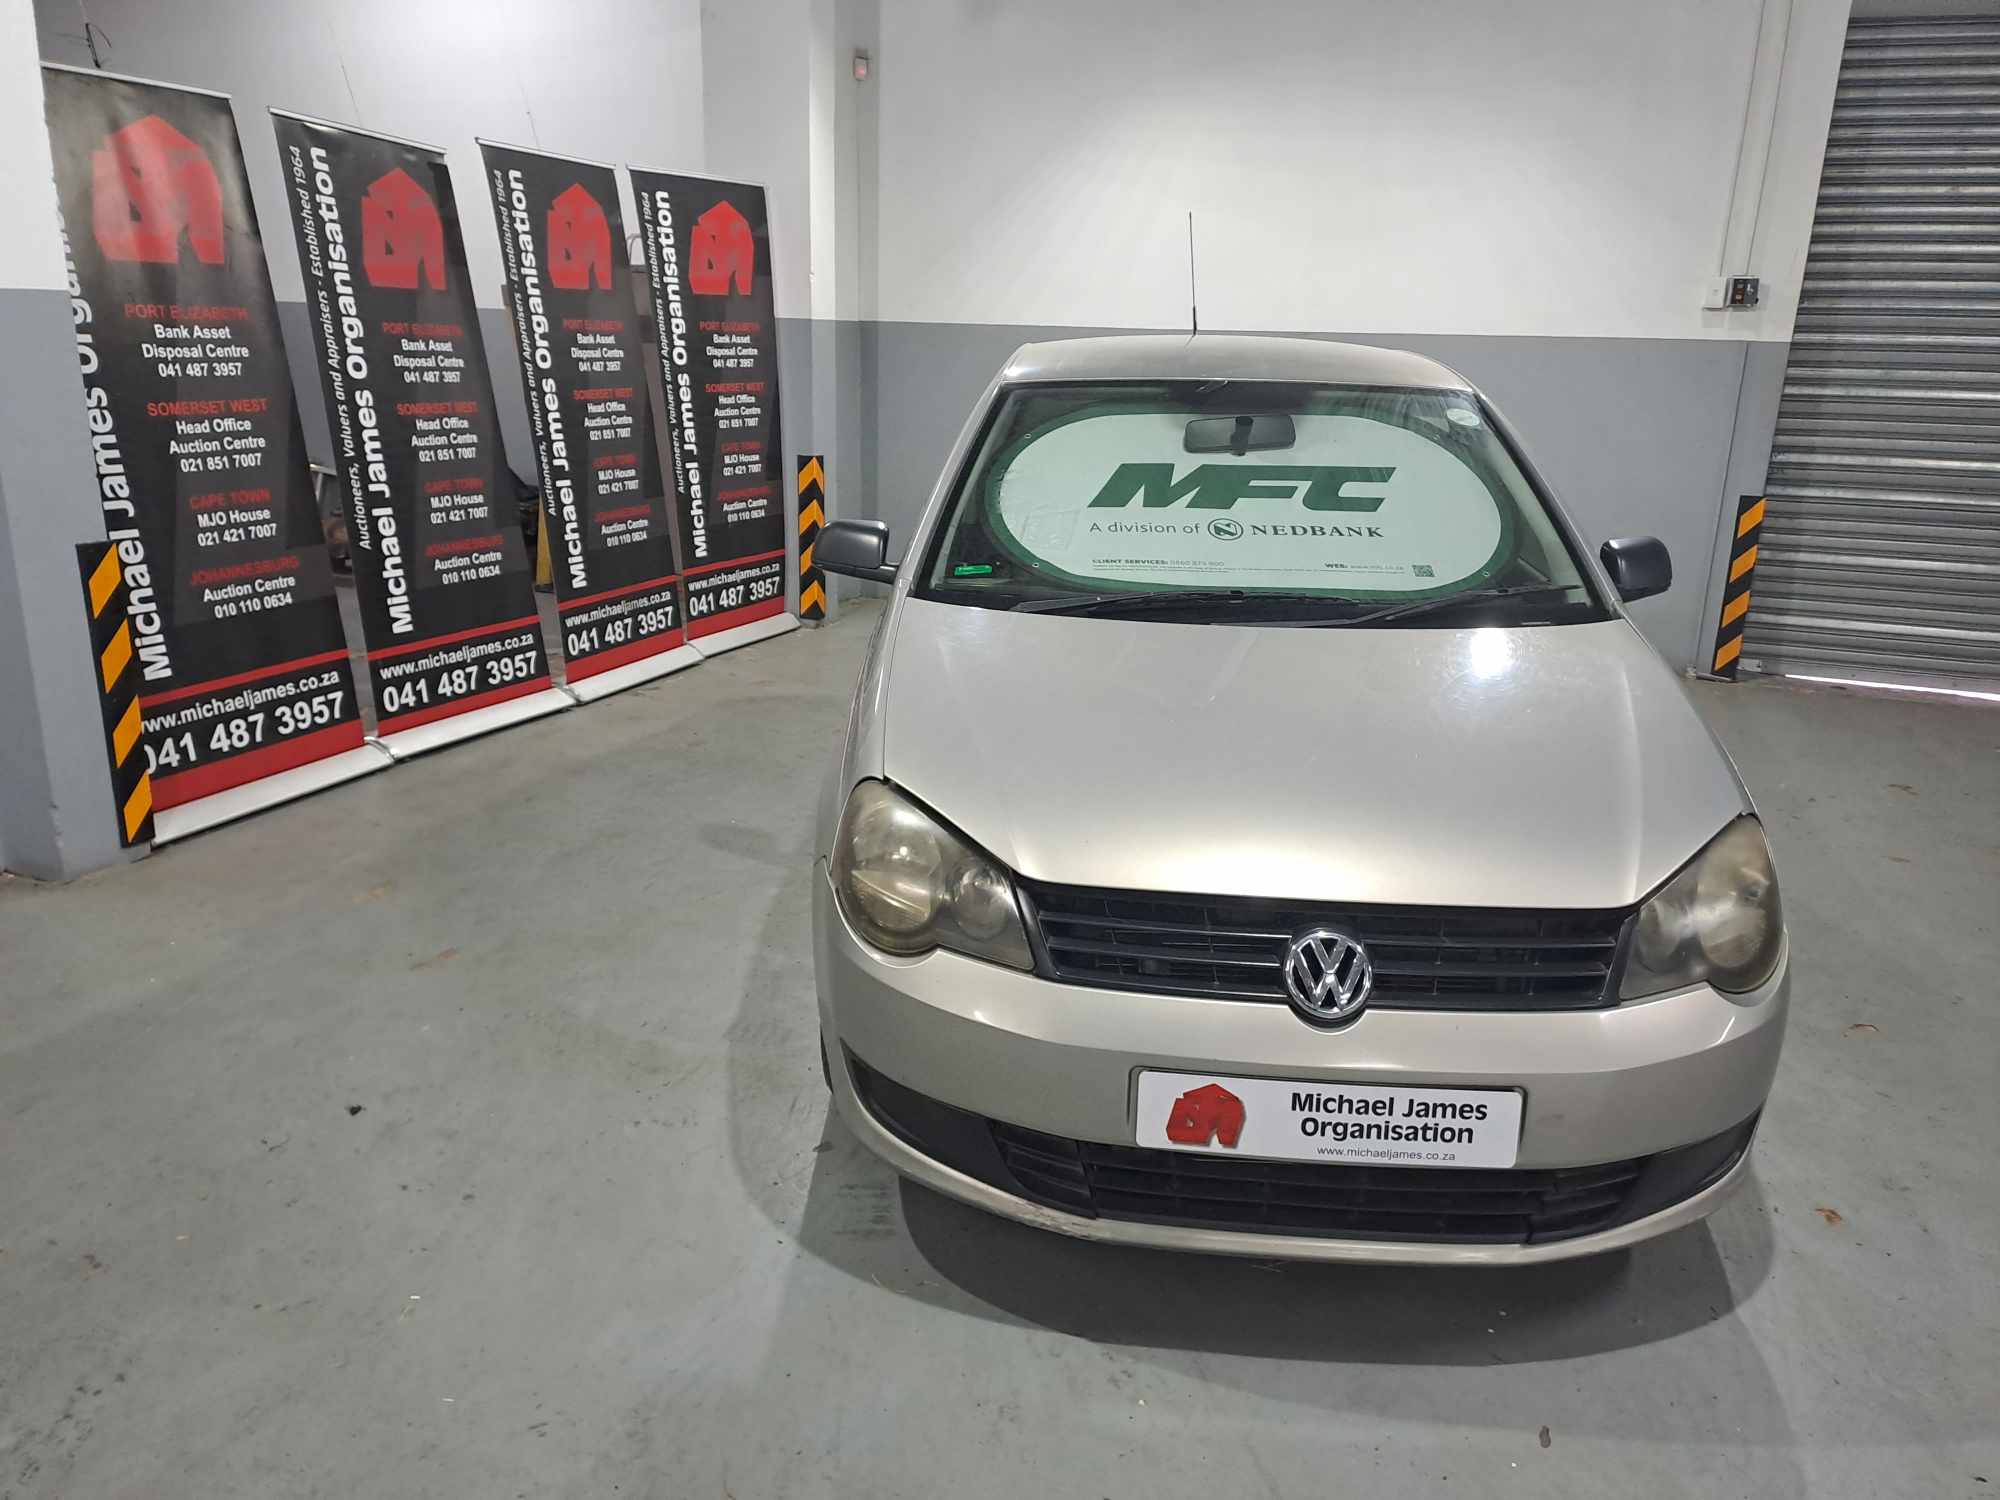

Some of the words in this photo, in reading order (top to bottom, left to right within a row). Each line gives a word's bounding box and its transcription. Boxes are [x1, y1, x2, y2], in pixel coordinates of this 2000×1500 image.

[289, 145, 306, 184] 1964
[296, 187, 323, 277] Established
[499, 205, 519, 281] Established
[310, 147, 368, 380] Organisation
[508, 169, 552, 369] Organisation
[655, 190, 687, 366] Organisation
[125, 304, 165, 318] PORT
[154, 324, 190, 339] Bank
[193, 325, 231, 339] Asset
[318, 290, 341, 369] Appraisers
[142, 343, 203, 360] Disposal
[206, 344, 249, 358] Centre
[401, 339, 427, 351] Bank
[158, 363, 182, 377] 041
[186, 363, 208, 376] 487
[212, 363, 242, 376] 3957
[393, 354, 436, 369] Disposal
[524, 361, 536, 388] and
[329, 371, 345, 401] and
[403, 371, 420, 383] 041
[423, 371, 439, 383] 487
[147, 400, 225, 416] SOMERSET
[677, 372, 697, 456] James
[176, 419, 210, 435] Head
[213, 417, 251, 432] Office
[338, 404, 355, 457] Valuers
[416, 418, 440, 430] Head
[442, 417, 469, 429] Office
[542, 377, 569, 472] James
[85, 387, 134, 517] James
[170, 439, 221, 455] Auction
[223, 435, 265, 450] Centre
[355, 390, 391, 498] James
[411, 434, 448, 447] Auction
[419, 450, 435, 462] 021
[437, 448, 454, 461] 851
[180, 458, 203, 473] 021
[207, 456, 229, 470] 851
[233, 453, 262, 468] 7007
[430, 495, 452, 508] MJO
[453, 494, 484, 506] House
[1087, 462, 1397, 512] MFC
[197, 512, 226, 527] MJO
[229, 509, 271, 524] House
[349, 463, 372, 550] Auctioneers,
[430, 512, 446, 524] 021
[449, 510, 465, 521] 421
[685, 462, 708, 559] Michael
[197, 532, 219, 547] 021
[223, 528, 245, 543] 421
[248, 523, 277, 539] 7007
[556, 479, 588, 589] Michael
[1089, 522, 1102, 533] A
[1108, 521, 1177, 534] division
[1183, 522, 1200, 534] of
[1251, 524, 1385, 538] NEDBANK
[372, 507, 414, 634] Michael
[434, 556, 470, 571] Auction
[472, 551, 502, 564] Centre
[203, 585, 252, 602] Auction
[255, 576, 296, 592] Centre
[442, 572, 459, 585] 010
[460, 569, 477, 582] 110
[688, 563, 780, 591] www.michaeljames.co.za
[109, 528, 173, 681] Michael
[214, 603, 237, 618] 010
[239, 598, 261, 614] 110
[264, 592, 293, 610] 0634
[565, 591, 672, 627] www.michaeljames.co.za
[689, 592, 715, 617] 041
[719, 585, 744, 608] 487
[749, 576, 780, 601] 3957
[567, 627, 599, 656] 041
[604, 617, 633, 644] 487
[637, 606, 673, 635] 3957
[380, 633, 534, 680] www.michaeljames.co.za
[383, 678, 429, 713] 041
[437, 665, 479, 697] 487
[486, 651, 537, 685] 3957
[142, 670, 340, 734] ww.michaeljames.co.za
[209, 713, 265, 753] 487
[274, 691, 344, 735] 3957
[1290, 1091, 1395, 1117] Michael
[1402, 1098, 1488, 1122] James
[1300, 1117, 1475, 1145] Organisation
[1317, 1145, 1456, 1162] www.michaeljames.co.za
